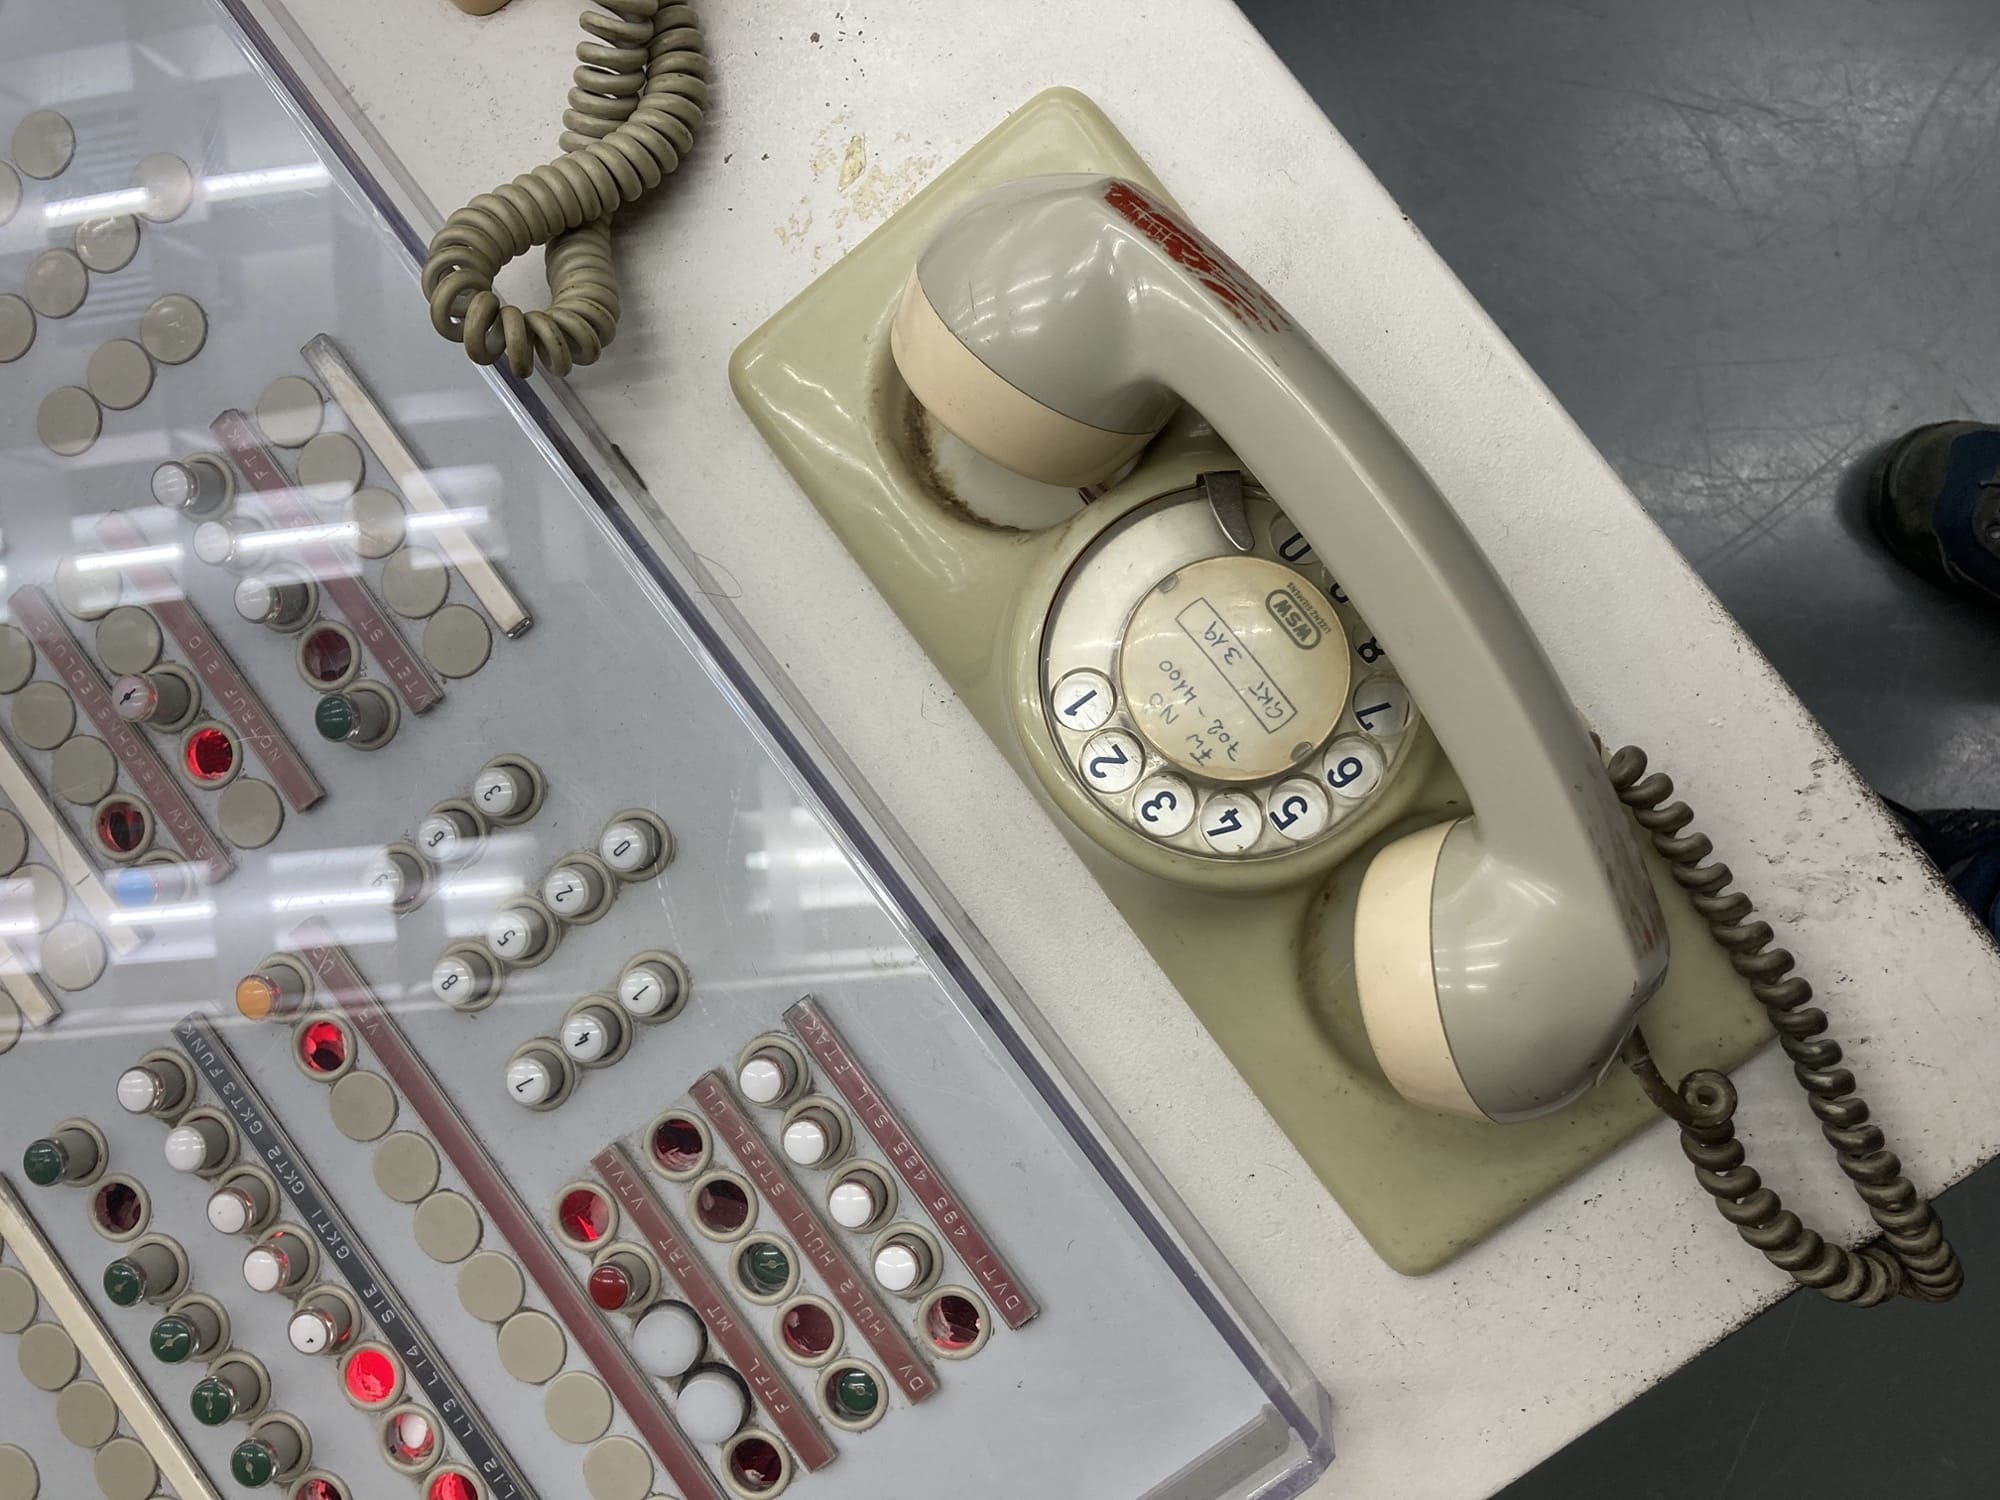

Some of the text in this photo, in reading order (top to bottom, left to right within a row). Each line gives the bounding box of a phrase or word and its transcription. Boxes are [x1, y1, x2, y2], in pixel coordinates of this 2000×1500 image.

[1273, 600, 1312, 642] WSW
[1204, 621, 1284, 719] GKT 319
[1064, 689, 1097, 717] 1
[1356, 702, 1391, 731] 7
[222, 684, 285, 762] NOTRUF
[1089, 744, 1128, 778] 2
[1328, 756, 1363, 788] 6
[483, 784, 502, 801] 3
[1141, 791, 1177, 822] 3
[1207, 808, 1242, 837] 4
[1270, 796, 1308, 831] 5
[428, 830, 445, 848] 6
[613, 840, 631, 857] 0
[555, 884, 574, 902] 2
[497, 929, 516, 947] 5
[441, 974, 458, 991] 8
[632, 985, 649, 1001] 1
[179, 1021, 226, 1079] FUNK
[574, 1031, 590, 1047] 4
[516, 1077, 534, 1093] 7
[218, 1078, 265, 1136] GKT3
[263, 1143, 307, 1197] GKT2
[728, 1123, 788, 1199] STFSL
[599, 1152, 649, 1212] VTVL
[931, 1193, 971, 1239] 495
[308, 1207, 352, 1261] GKT1
[360, 1281, 397, 1325] SIE
[704, 1300, 735, 1334] MT
[403, 1342, 440, 1387] L14
[898, 1360, 927, 1392] DV
[743, 1355, 793, 1415] FTFL
[439, 1396, 475, 1438] L13
